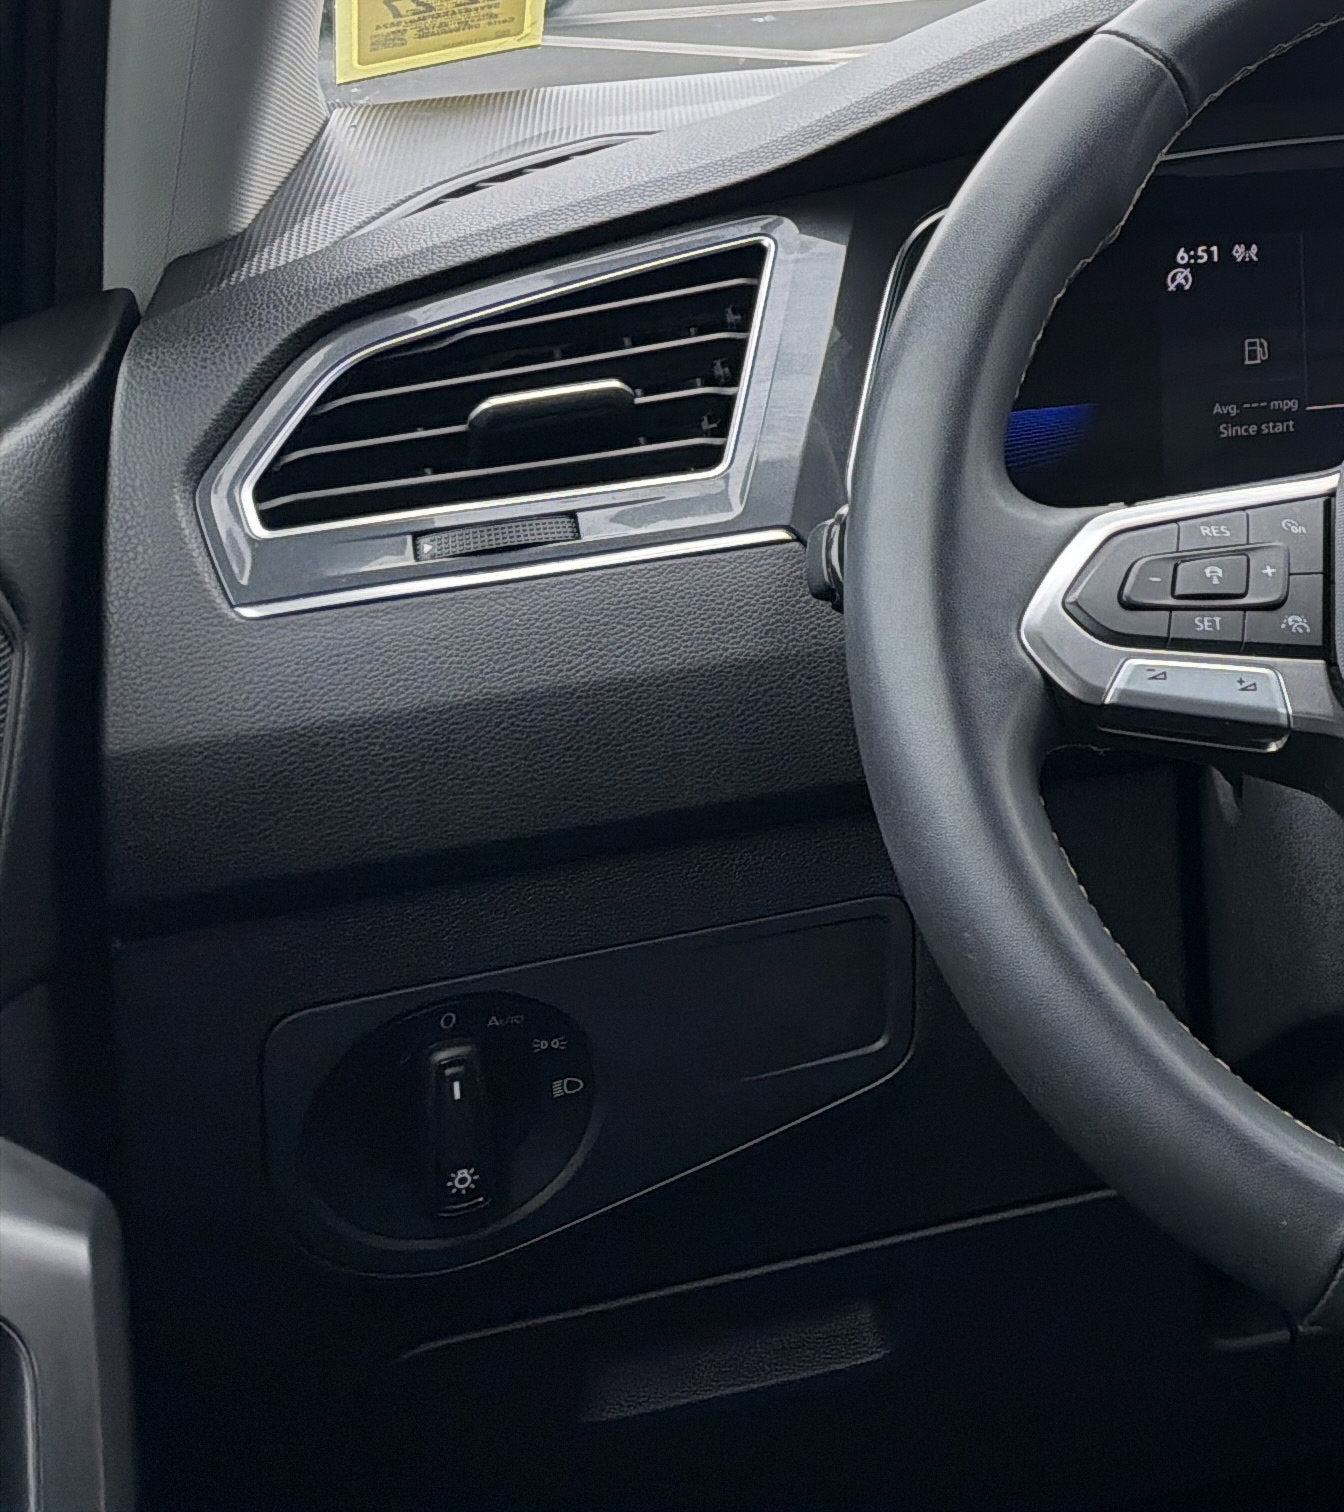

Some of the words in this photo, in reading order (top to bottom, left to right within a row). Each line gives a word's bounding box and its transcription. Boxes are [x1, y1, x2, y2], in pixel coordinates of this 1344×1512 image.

[1176, 245, 1219, 265] 6:51
[1212, 402, 1241, 417] Avg.
[1270, 398, 1299, 412] mpg
[1220, 423, 1258, 438] Since
[1260, 419, 1295, 434] start
[1200, 524, 1231, 538] RES
[1194, 616, 1222, 632] SET
